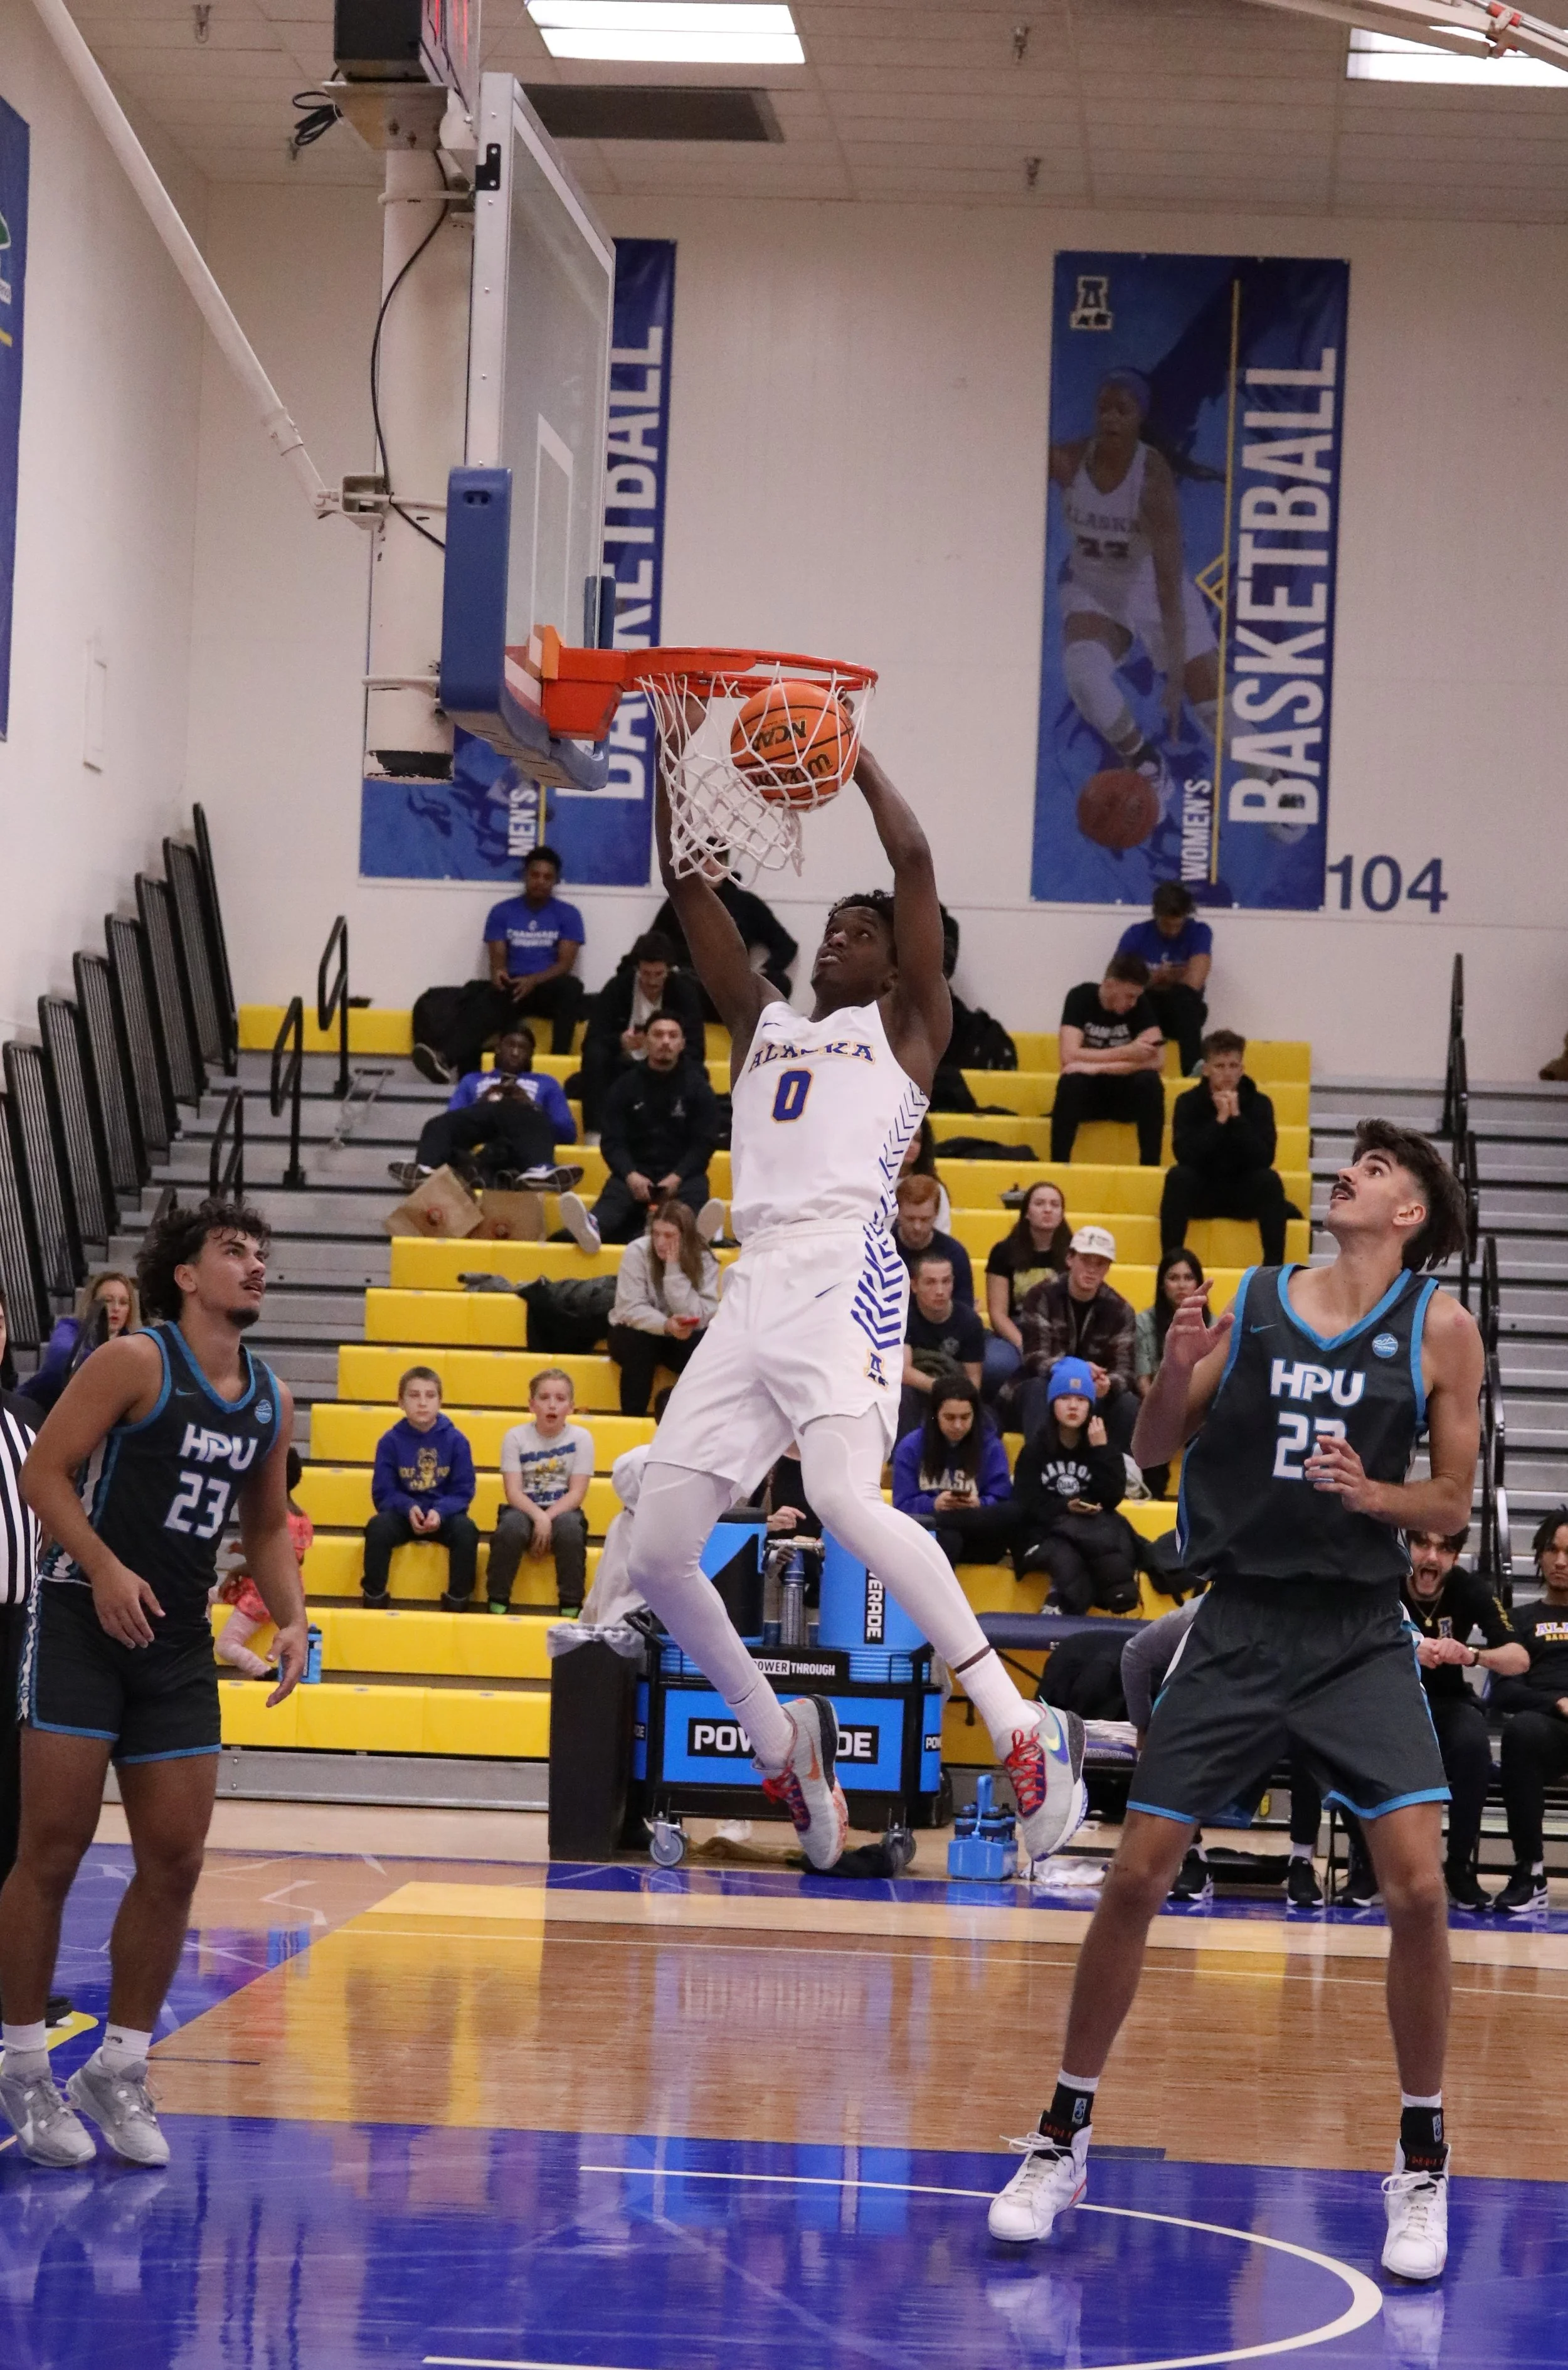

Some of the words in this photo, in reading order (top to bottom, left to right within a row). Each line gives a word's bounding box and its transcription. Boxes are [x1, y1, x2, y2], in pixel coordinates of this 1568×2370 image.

[1227, 347, 1335, 824] BASKETBALL
[507, 788, 537, 856] MEN'S
[1180, 778, 1212, 881] WOMEN'S
[1327, 854, 1448, 914] 104
[770, 1067, 813, 1124] 0
[1269, 1358, 1366, 1408] HPU
[179, 1422, 258, 1471] HPU
[164, 1470, 231, 1539] 23
[866, 1571, 883, 1639] ERADE
[790, 1662, 835, 1676] THROUGH
